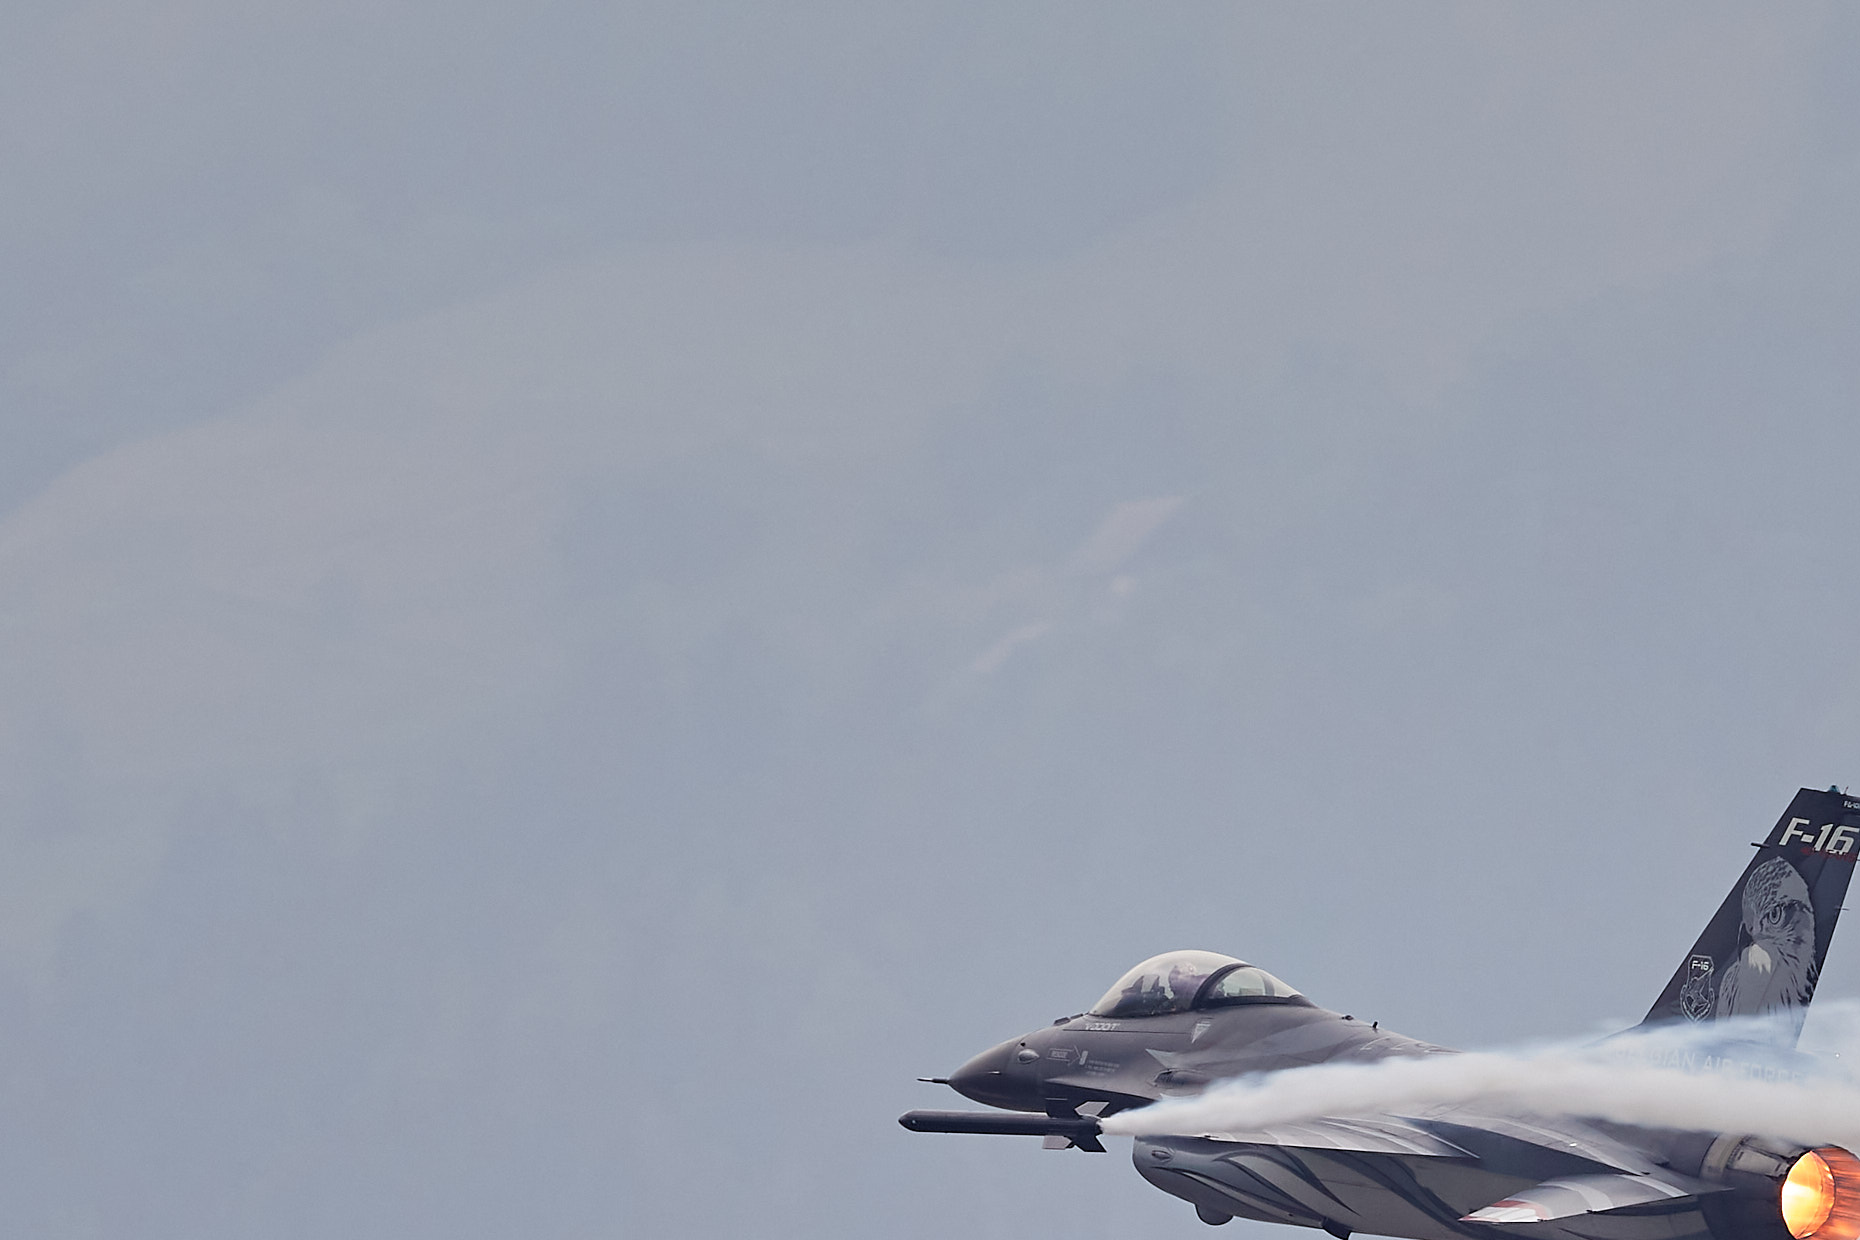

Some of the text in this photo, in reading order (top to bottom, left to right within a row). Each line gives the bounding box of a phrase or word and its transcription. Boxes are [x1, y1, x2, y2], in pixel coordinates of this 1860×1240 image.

[1778, 817, 1860, 855] F-16
[1691, 960, 1711, 971] F-16
[1615, 1045, 1697, 1069] GIAN
